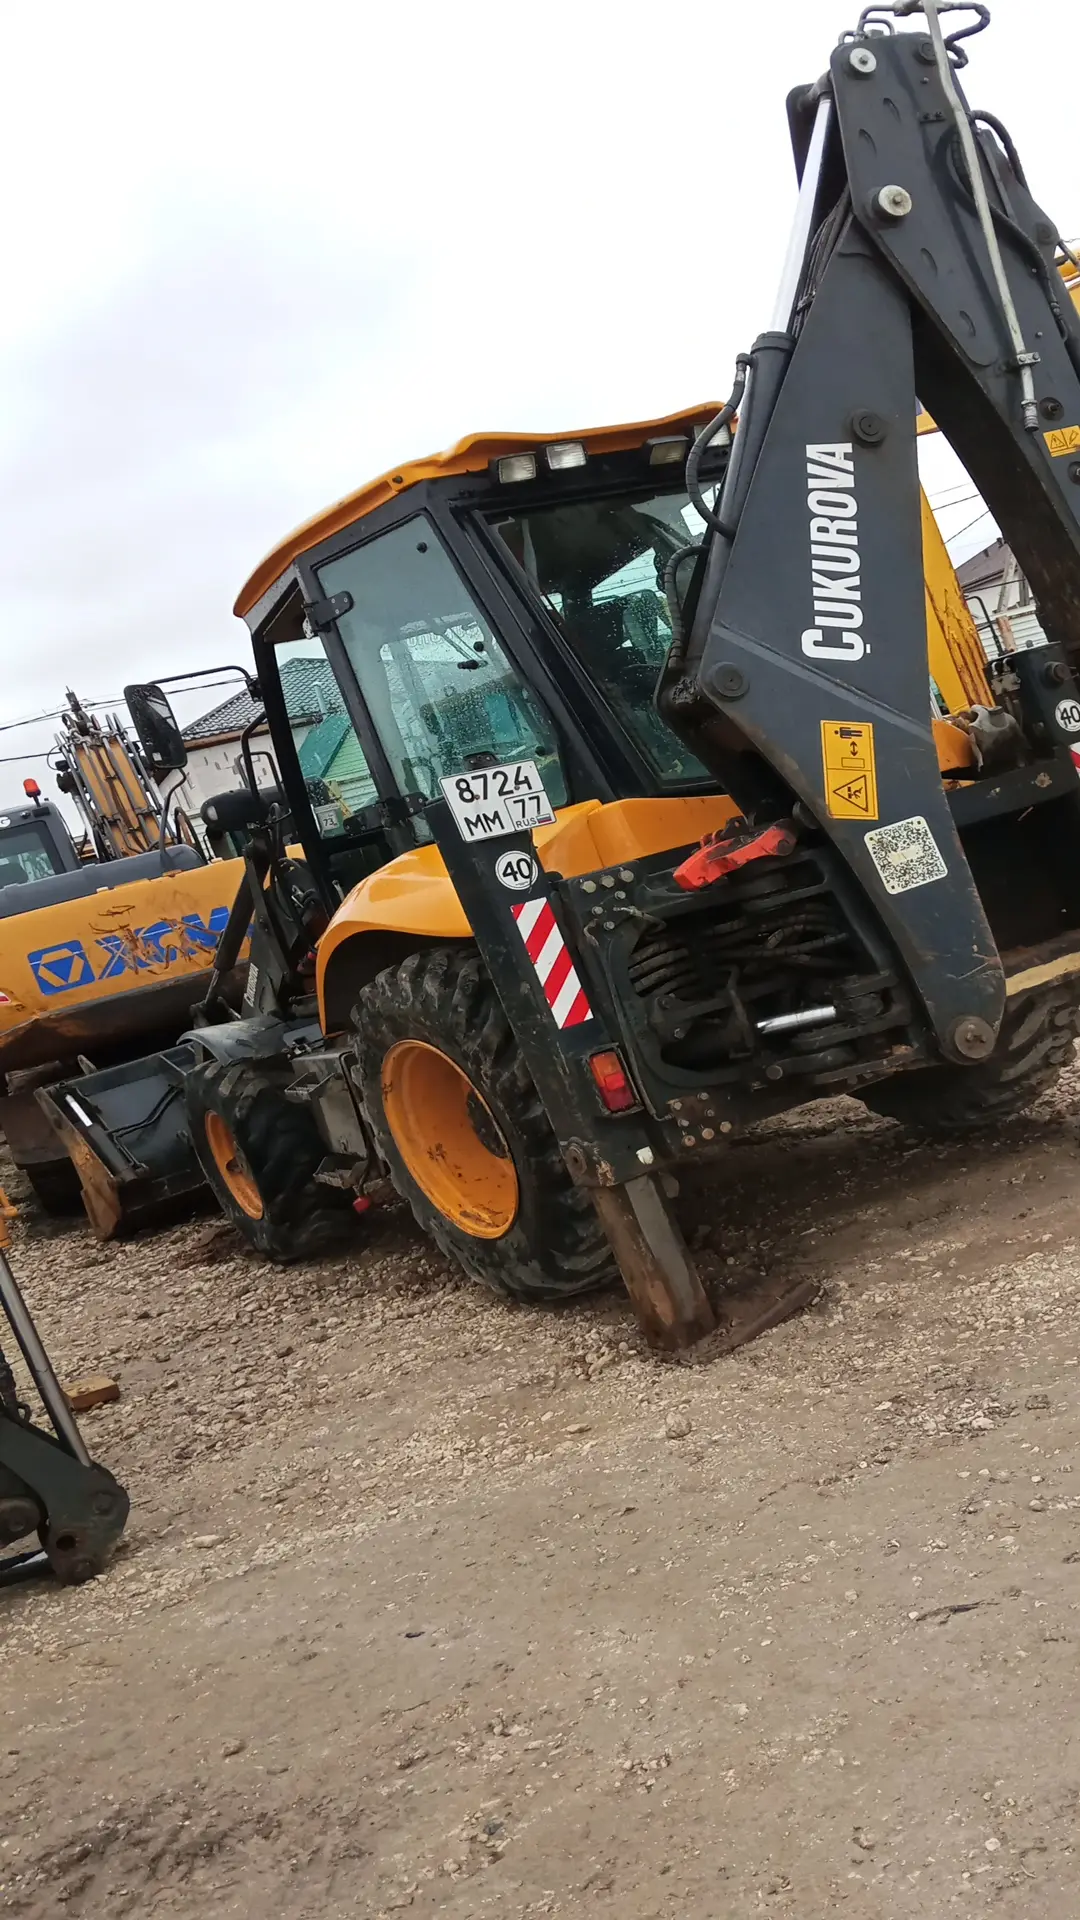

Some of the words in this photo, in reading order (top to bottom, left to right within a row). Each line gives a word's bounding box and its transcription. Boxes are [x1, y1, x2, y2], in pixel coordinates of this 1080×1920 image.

[801, 443, 871, 661] ÇUKUROVA
[1060, 705, 1080, 725] 40
[455, 766, 532, 803] 8724
[513, 795, 540, 818] 77
[464, 811, 505, 836] MM
[515, 817, 537, 828] RUS
[502, 858, 532, 882] 40
